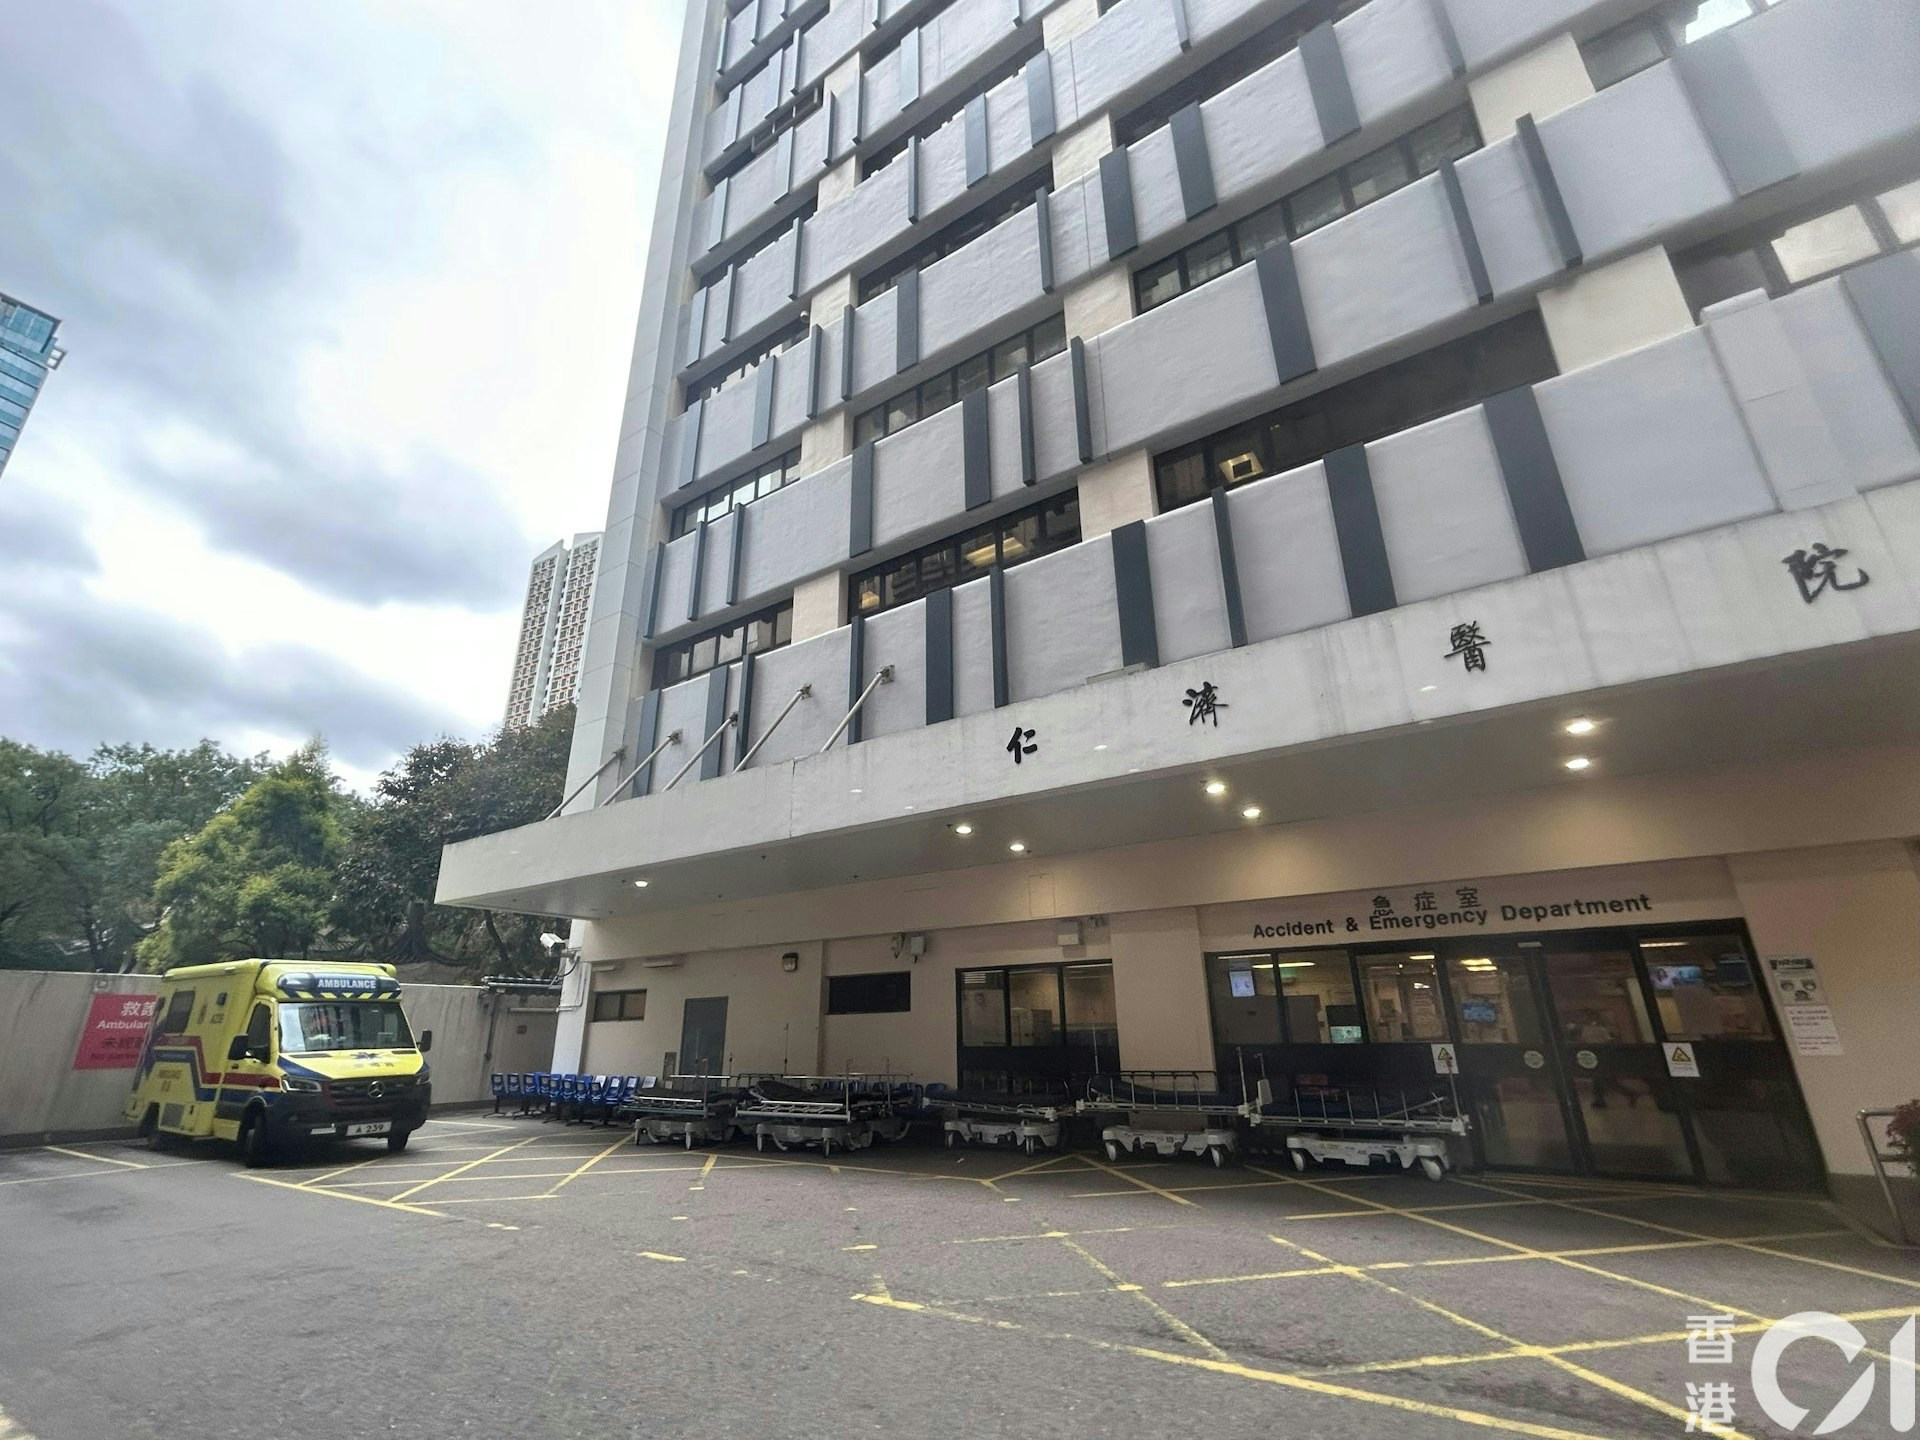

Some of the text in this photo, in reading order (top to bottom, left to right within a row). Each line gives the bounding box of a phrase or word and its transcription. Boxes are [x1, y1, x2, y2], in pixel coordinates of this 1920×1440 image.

[1006, 542, 1870, 765] 仁濟醫院
[1253, 893, 1652, 938] Accident & Emergency Department
[1372, 886, 1481, 916] 急症室
[317, 979, 377, 989] AMBULANCE
